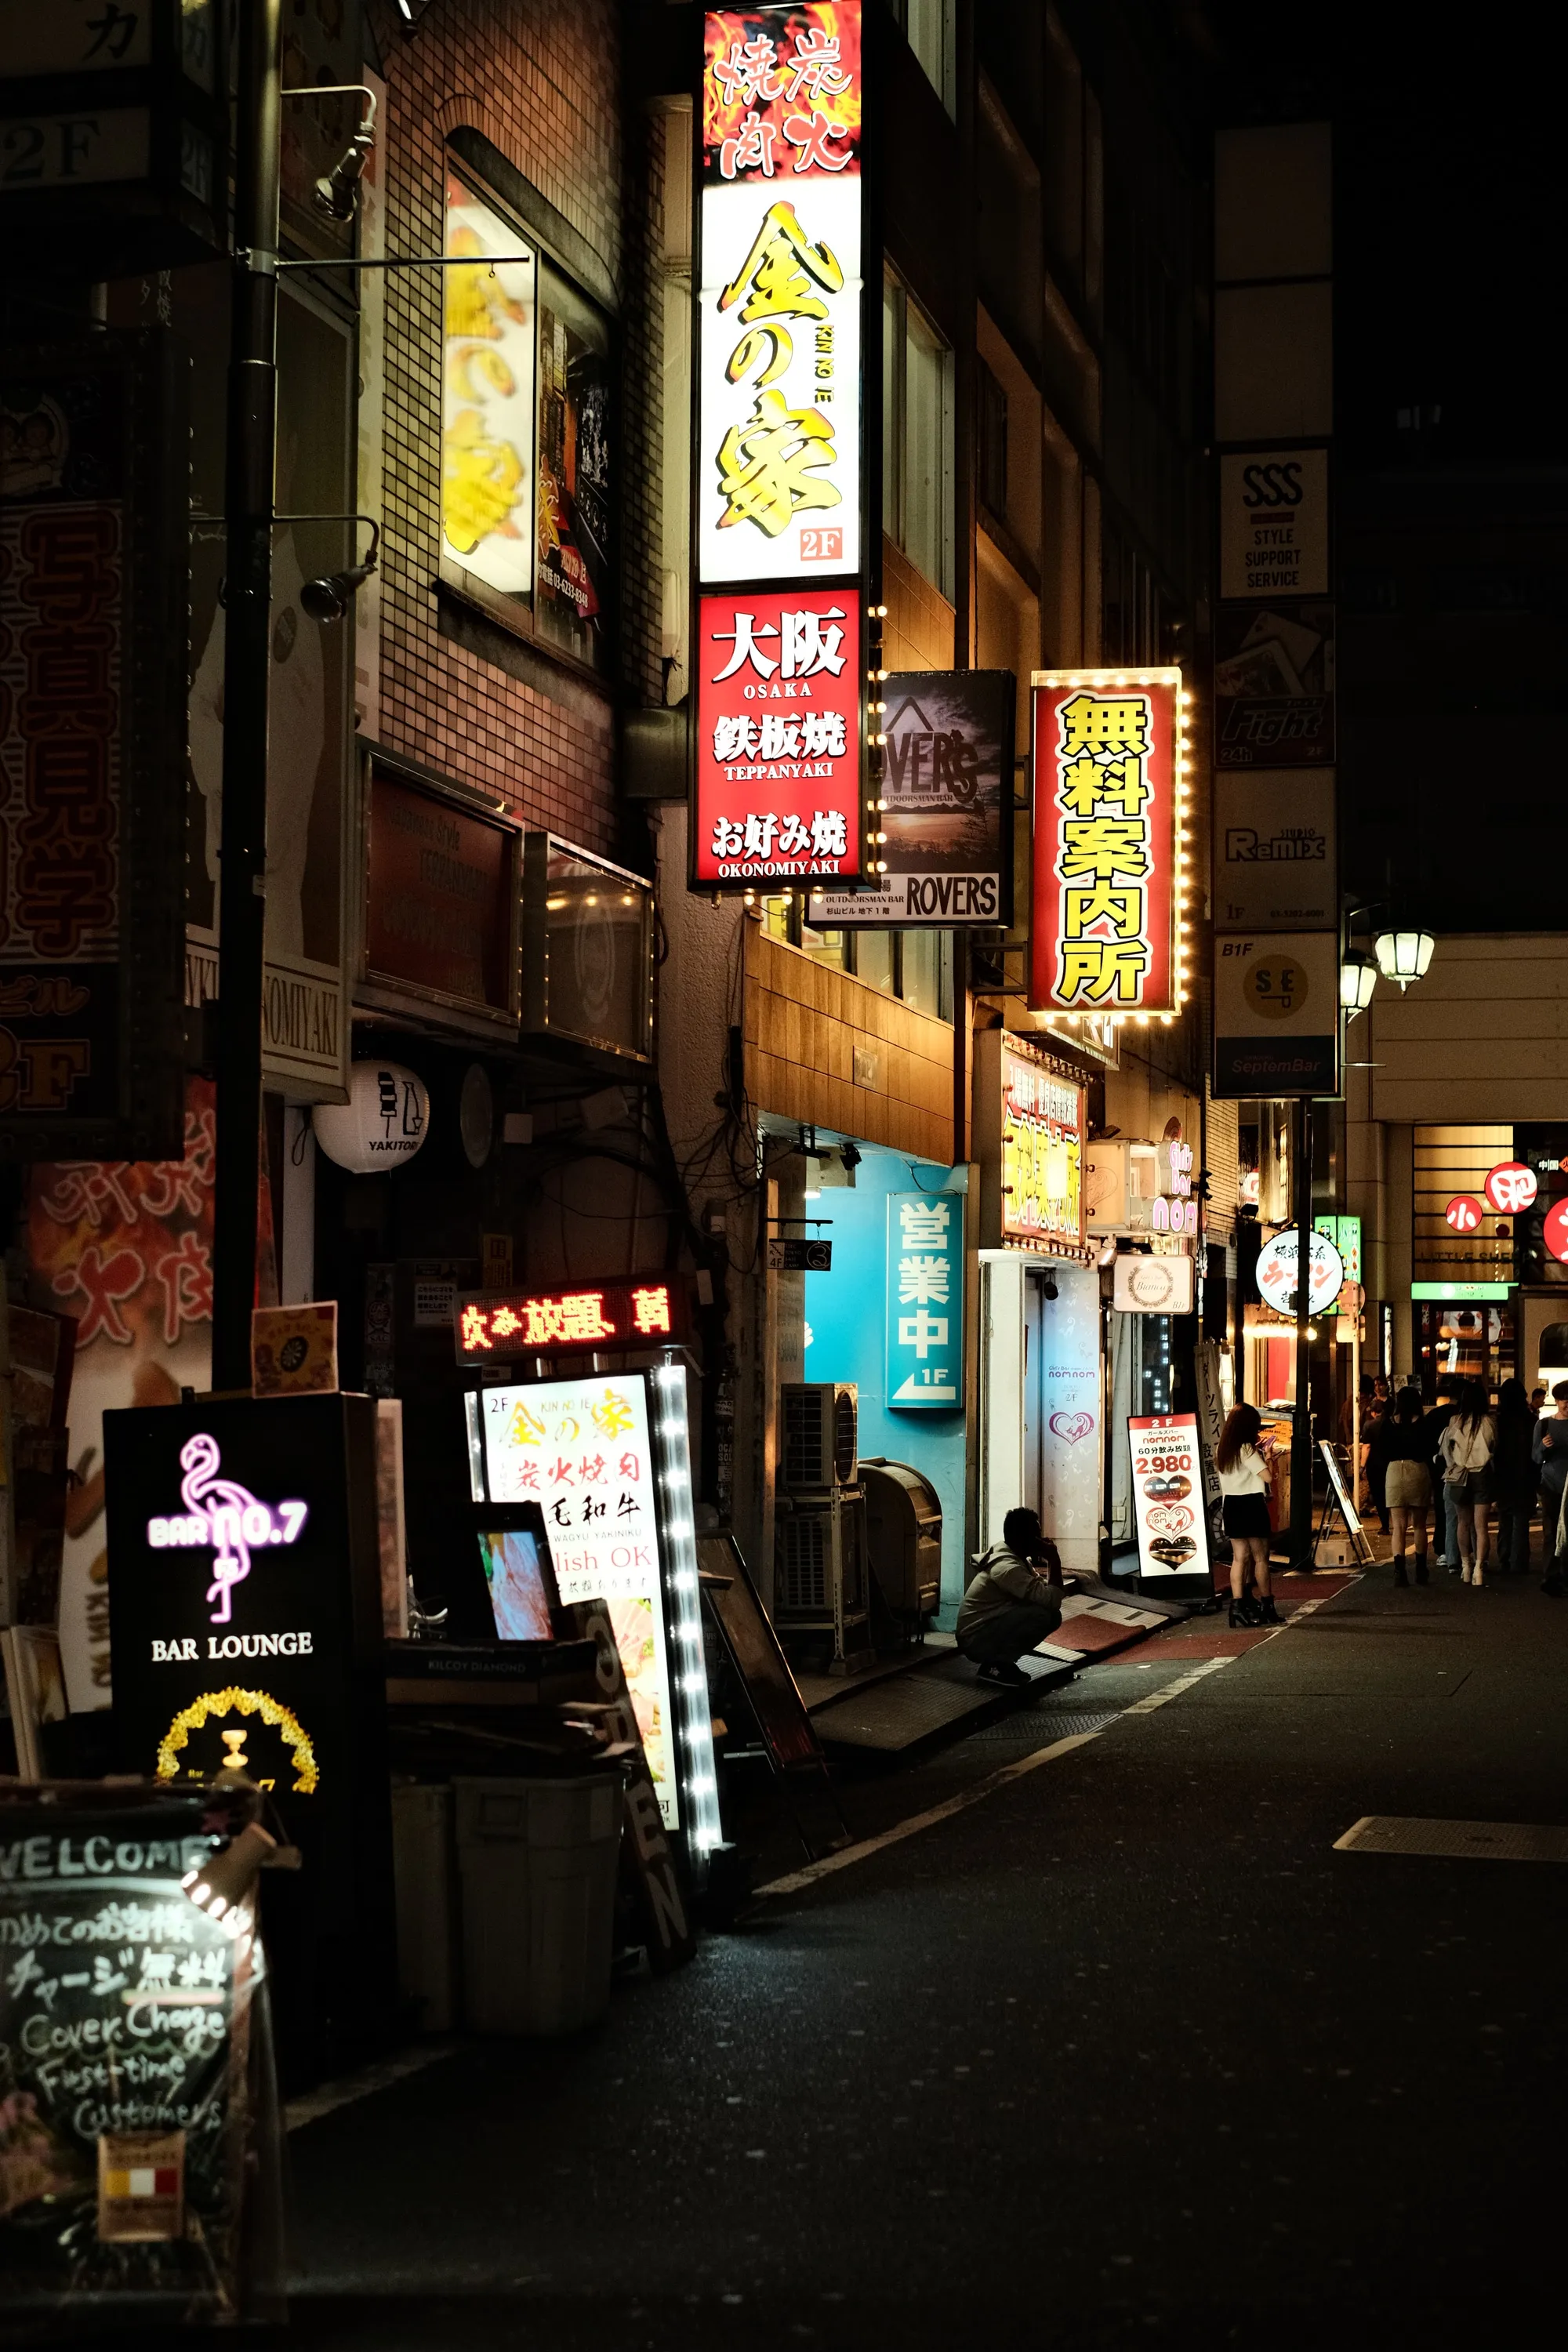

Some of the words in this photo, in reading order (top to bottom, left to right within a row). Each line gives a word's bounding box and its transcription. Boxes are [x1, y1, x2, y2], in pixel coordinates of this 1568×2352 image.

[713, 34, 785, 180] 焼肉
[783, 27, 853, 173] 炭火
[2, 120, 100, 181] 2F
[815, 324, 835, 354] KIN
[714, 200, 844, 539] 金の家
[815, 358, 835, 379] NO
[815, 385, 834, 403] IE
[1243, 462, 1303, 507] SSS
[802, 528, 842, 557] 2F
[1254, 528, 1294, 545] STYLE
[1245, 550, 1301, 567] SUPPORT
[1247, 571, 1299, 588] SERVICE
[712, 606, 847, 684] 大阪
[744, 682, 813, 700] OSAKA
[713, 711, 847, 764] 鉄板焼
[1305, 746, 1326, 757] 2F
[724, 762, 833, 782] TEPPANYAKI
[881, 729, 979, 804] VERS
[711, 810, 848, 860] お好み焼
[1056, 694, 1150, 1003] 無料案内所
[717, 859, 840, 879] OKONOMIYAKI
[906, 877, 996, 916] ROVERS
[1226, 903, 1246, 920] 1F
[1222, 943, 1254, 956] B1F
[1232, 1058, 1321, 1076] SeptemBar
[1446, 1203, 1476, 1230] 小
[770, 1258, 782, 1268] 4F
[1273, 1245, 1327, 1261] 横浜系
[898, 1202, 951, 1359] 営業中
[922, 1368, 949, 1385] 1F
[491, 1397, 510, 1413] 2F
[541, 1401, 558, 1413] KIN
[580, 1399, 590, 1410] IE
[499, 1387, 635, 1449] 金の家
[1138, 1444, 1191, 1455] 60分飲み放題
[1143, 1435, 1185, 1444] nomnom
[514, 1451, 640, 1491] 炭火焼肉
[147, 1516, 209, 1548] BAR
[554, 1532, 589, 1543] WAGYU
[593, 1530, 642, 1540] YAKINIKU
[554, 1549, 598, 1573] lish
[610, 1545, 652, 1568] OK
[151, 1638, 200, 1662] BAR
[208, 1631, 314, 1660] LOUNGE
[428, 1659, 469, 1671] KILCOY
[471, 1661, 527, 1674] DIAMOND
